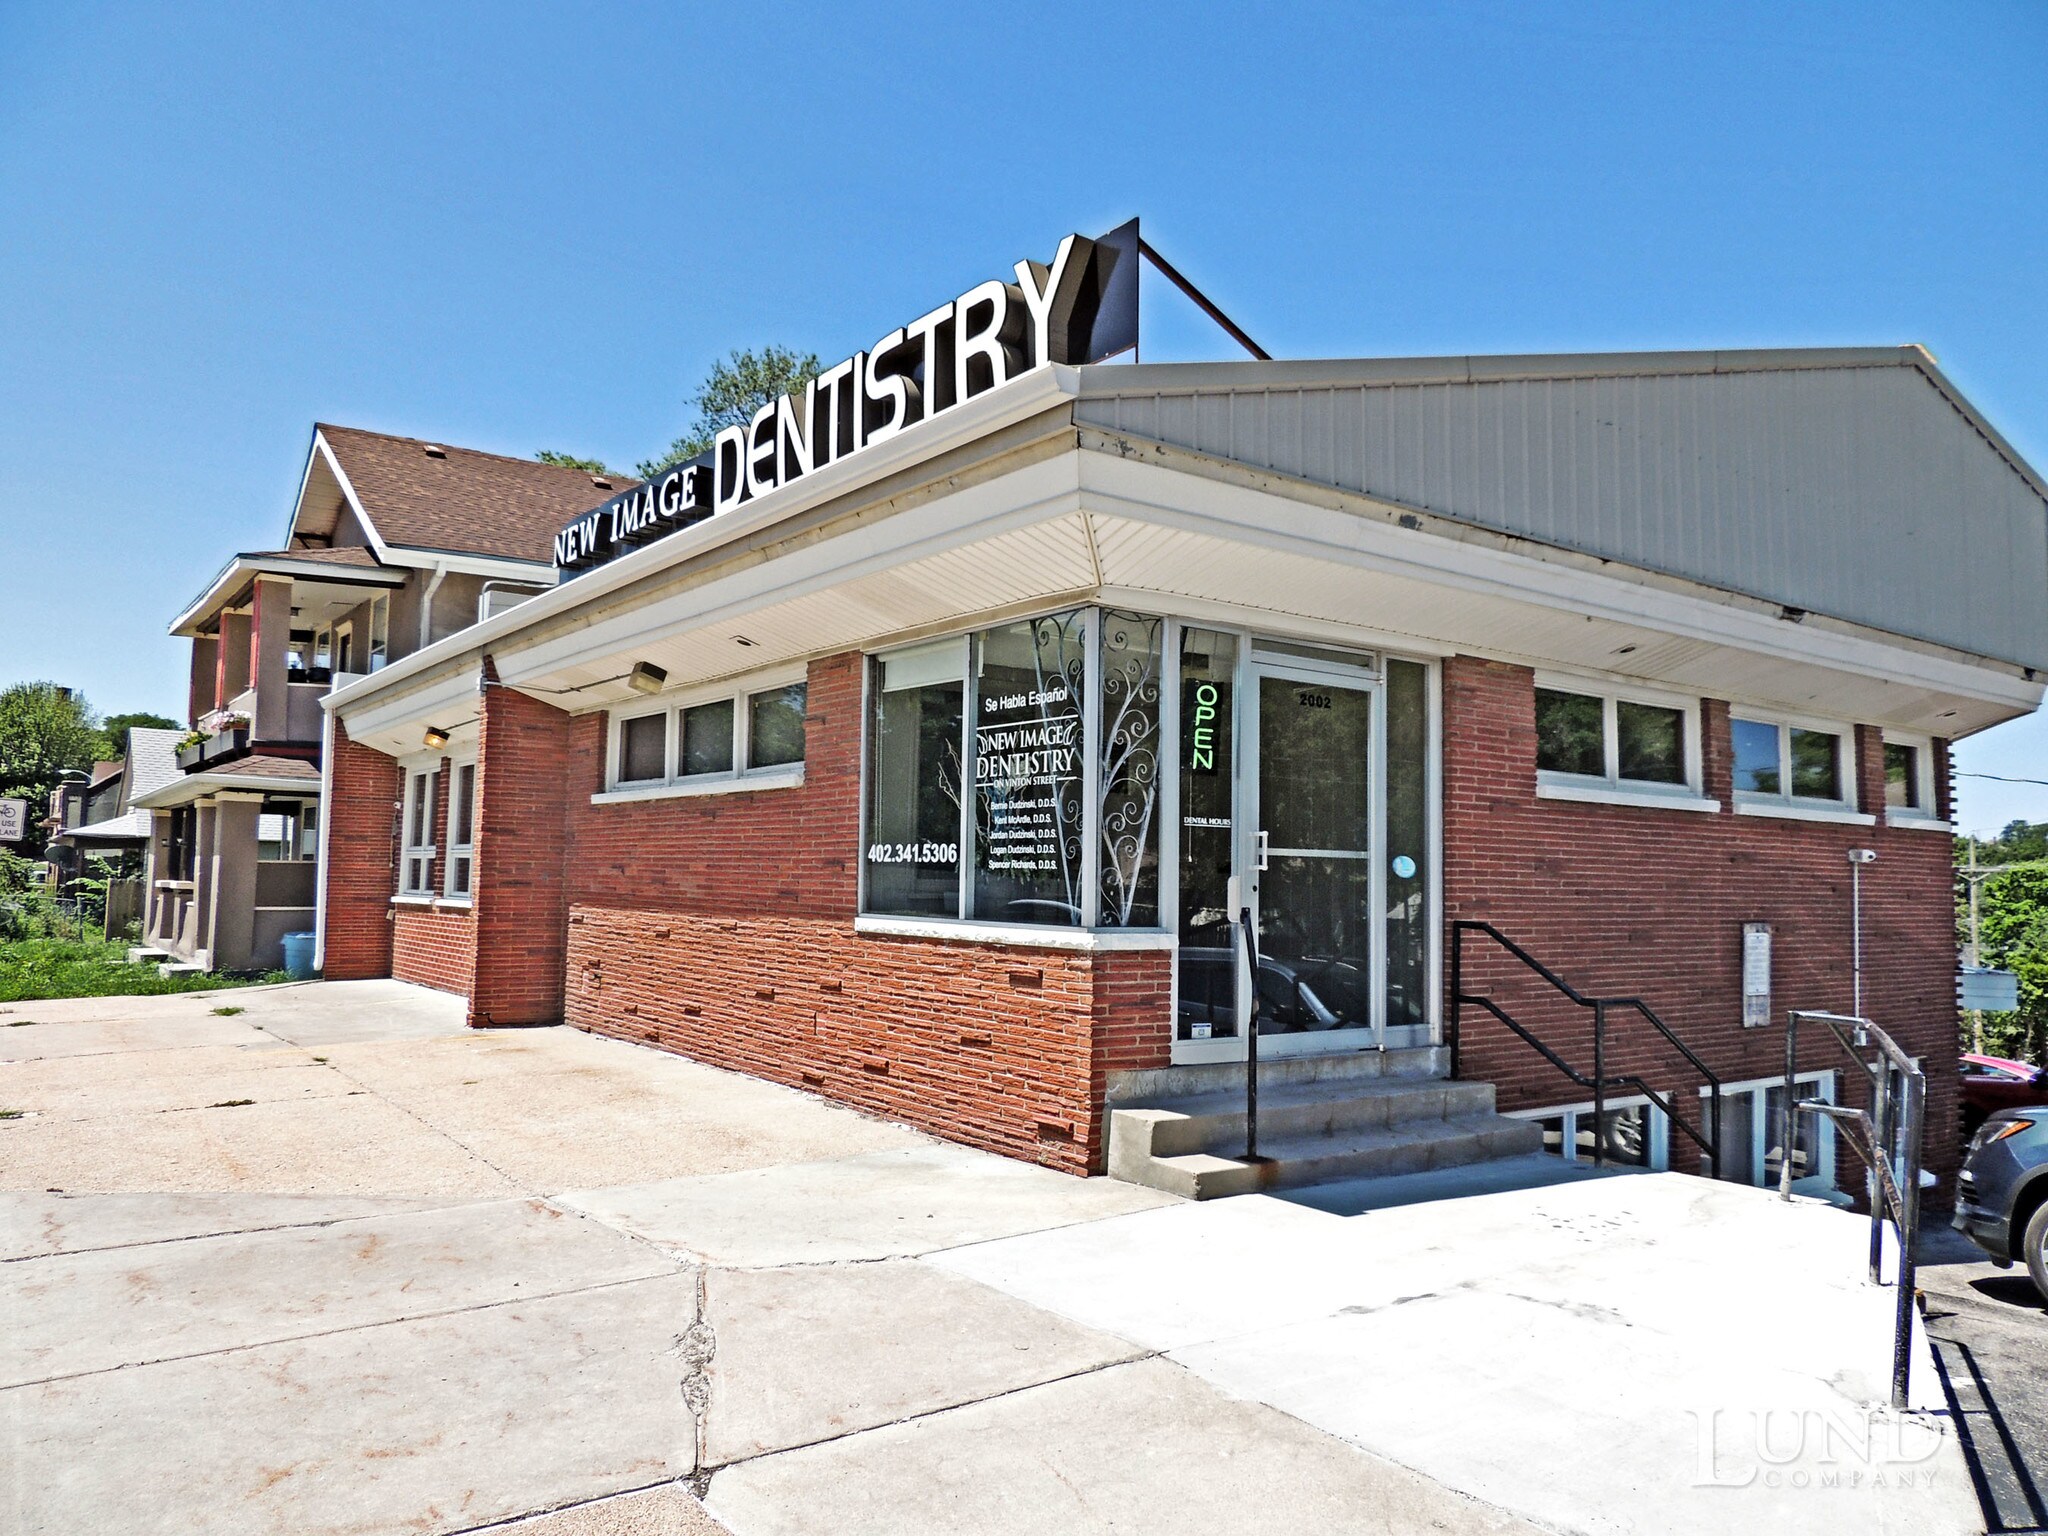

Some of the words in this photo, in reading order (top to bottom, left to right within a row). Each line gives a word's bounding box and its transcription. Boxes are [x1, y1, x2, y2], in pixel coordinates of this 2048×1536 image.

[713, 233, 1078, 516] DENTISTRY
[552, 513, 600, 568] NEW
[610, 465, 697, 543] IMAGE
[985, 698, 998, 713] Se
[1000, 693, 1027, 710] Habla
[1028, 686, 1068, 707] Español
[1300, 693, 1331, 709] 2002
[1192, 684, 1218, 770] OPEN
[988, 731, 1018, 752] NEW
[1020, 725, 1063, 748] IMAGE
[976, 748, 1076, 779] DENTISTRY
[993, 779, 1004, 788] ON
[1004, 777, 1032, 788] VINTON
[1032, 775, 1058, 785] STREET
[1, 820, 17, 828] USE
[1033, 813, 1053, 824] D.D.S.
[1183, 816, 1208, 825] DENTAL
[1208, 817, 1232, 826] HOURS
[1038, 828, 1058, 839] D.D.S.
[867, 843, 958, 863] 402.341.5306
[989, 845, 1007, 856] Logan
[1036, 844, 1057, 854] D.D.S.
[988, 860, 1011, 870] Spencer
[1038, 859, 1058, 870] D.D.S.
